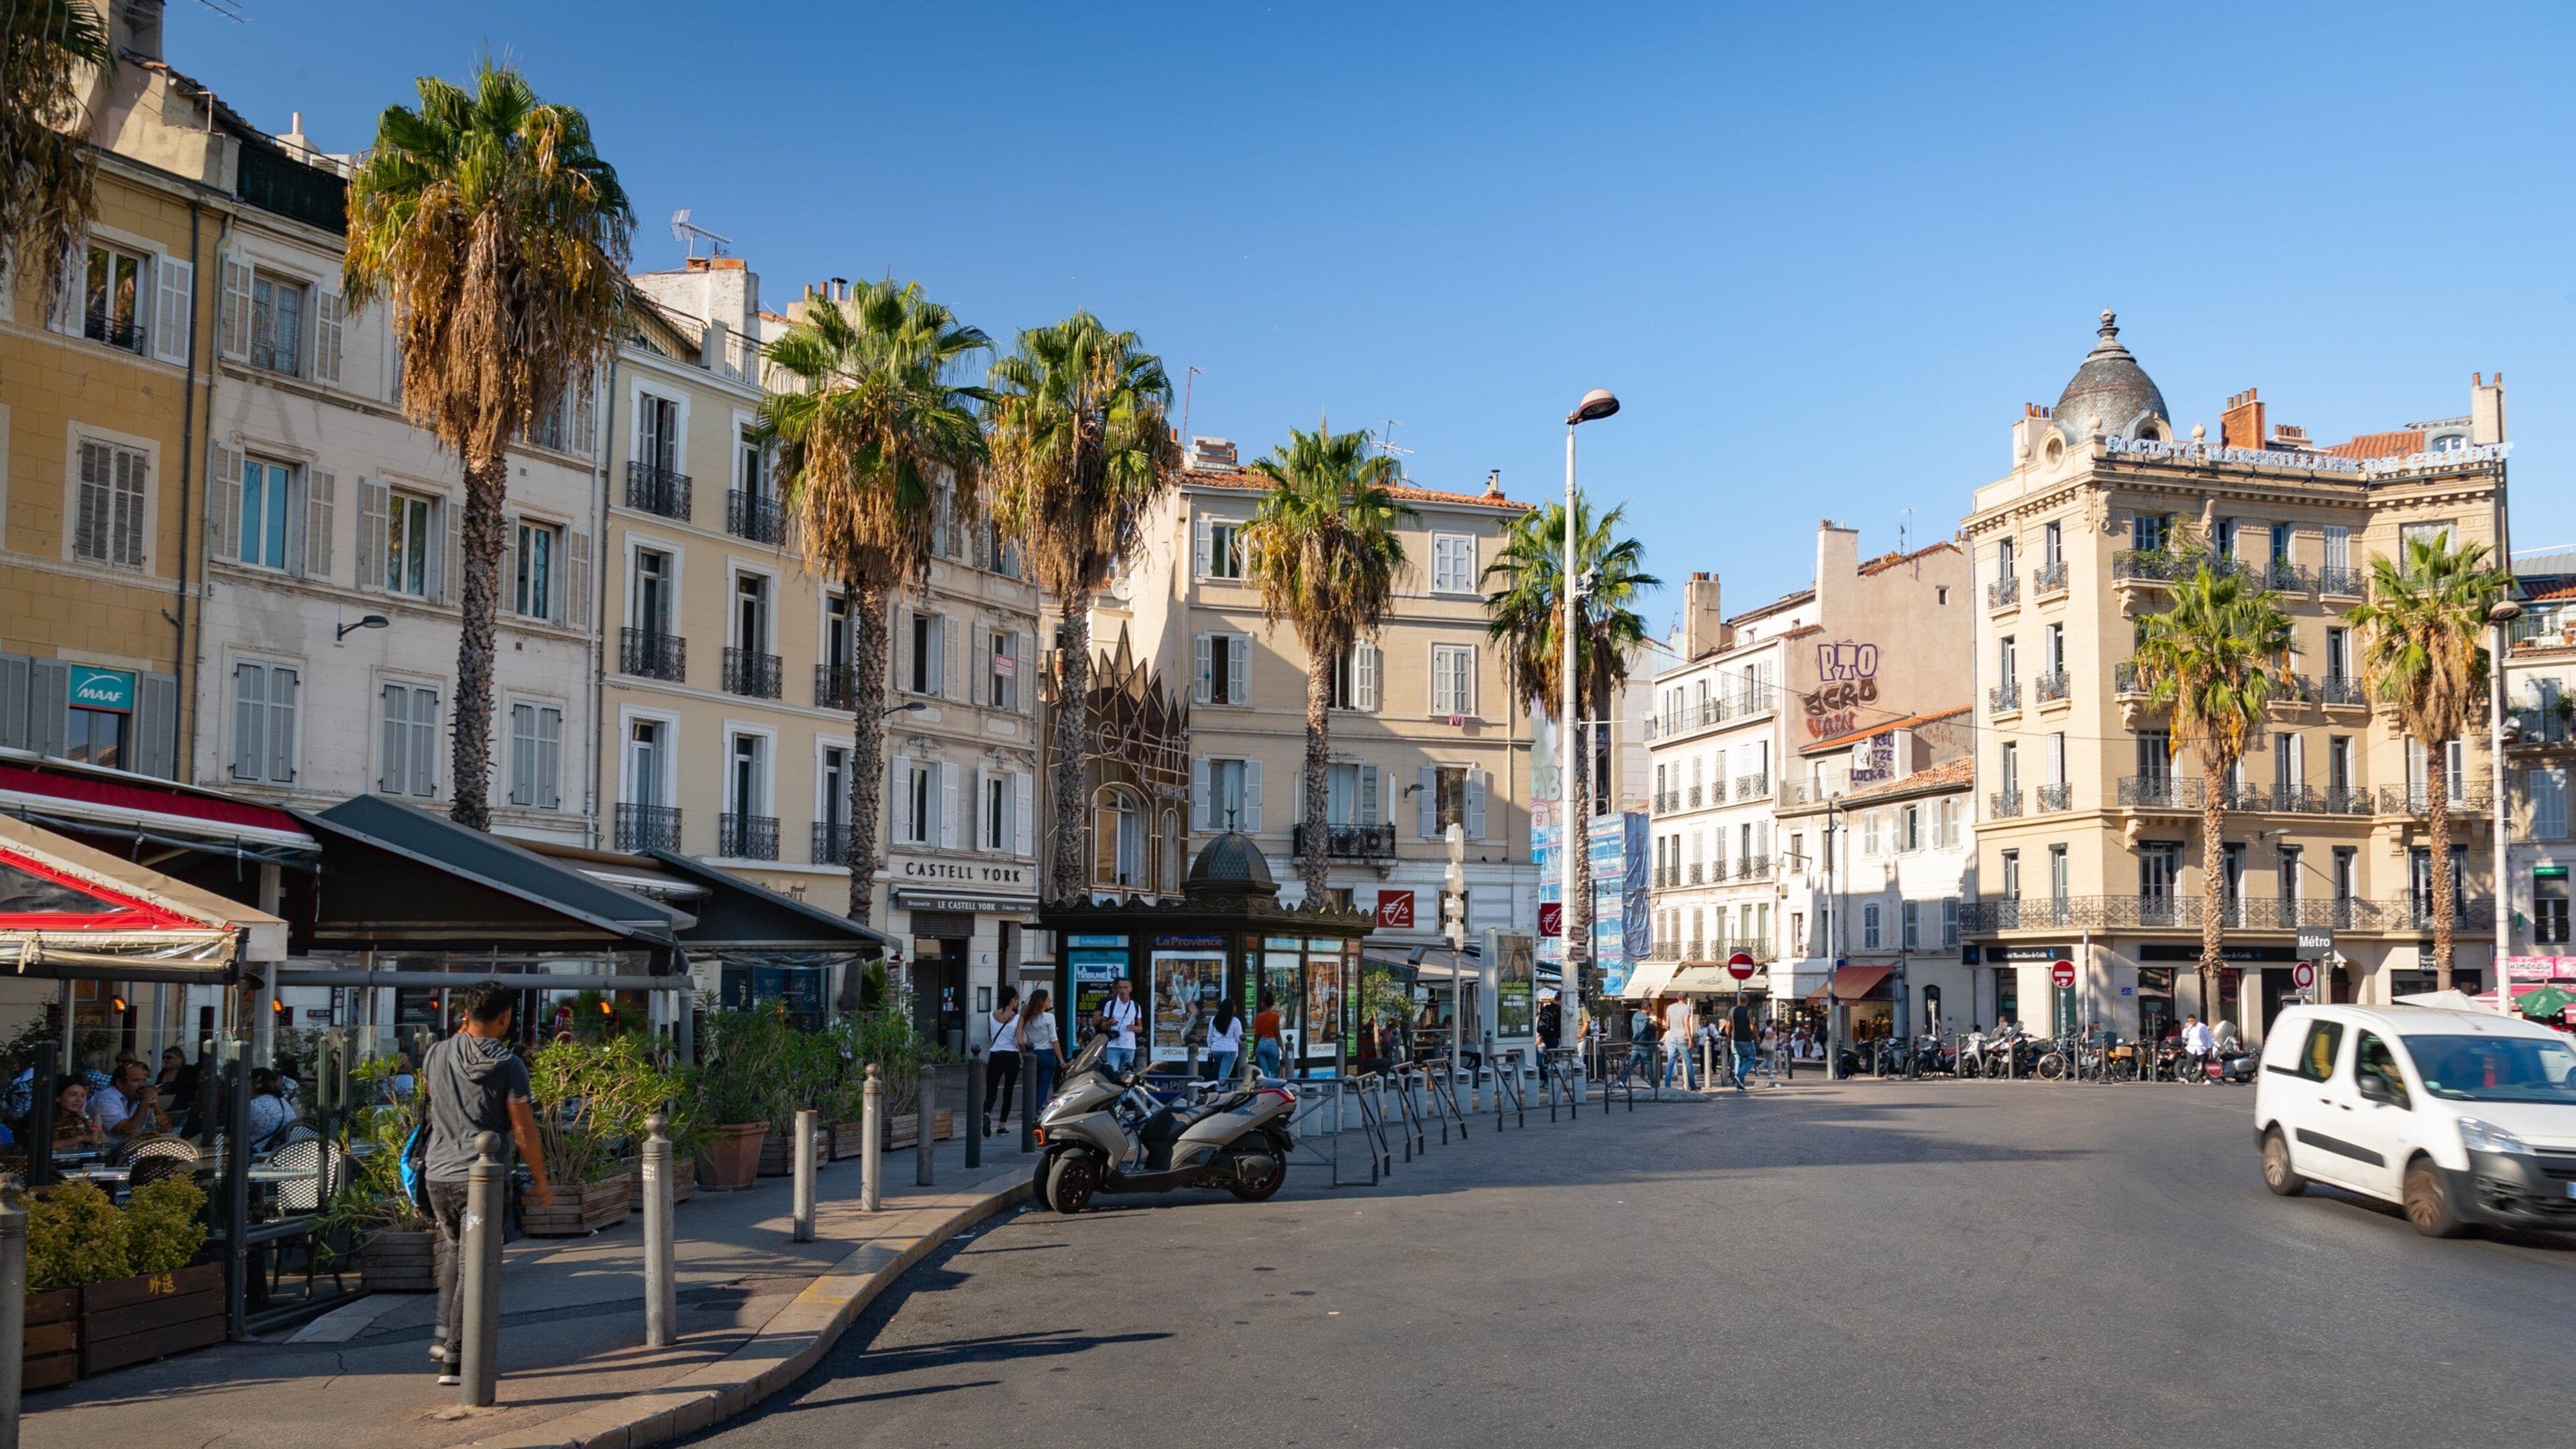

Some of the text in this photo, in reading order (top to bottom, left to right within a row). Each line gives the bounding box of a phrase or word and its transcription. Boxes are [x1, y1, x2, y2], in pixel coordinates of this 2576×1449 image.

[2203, 444, 2359, 474] MARSEILLAISE
[2364, 456, 2400, 474] DE
[78, 688, 123, 702] MAAF
[906, 862, 1020, 882] CASTELL YORK
[908, 900, 930, 908] Brasserie
[938, 901, 996, 911] LE CASTELL YORK
[2299, 935, 2330, 947] Métro
